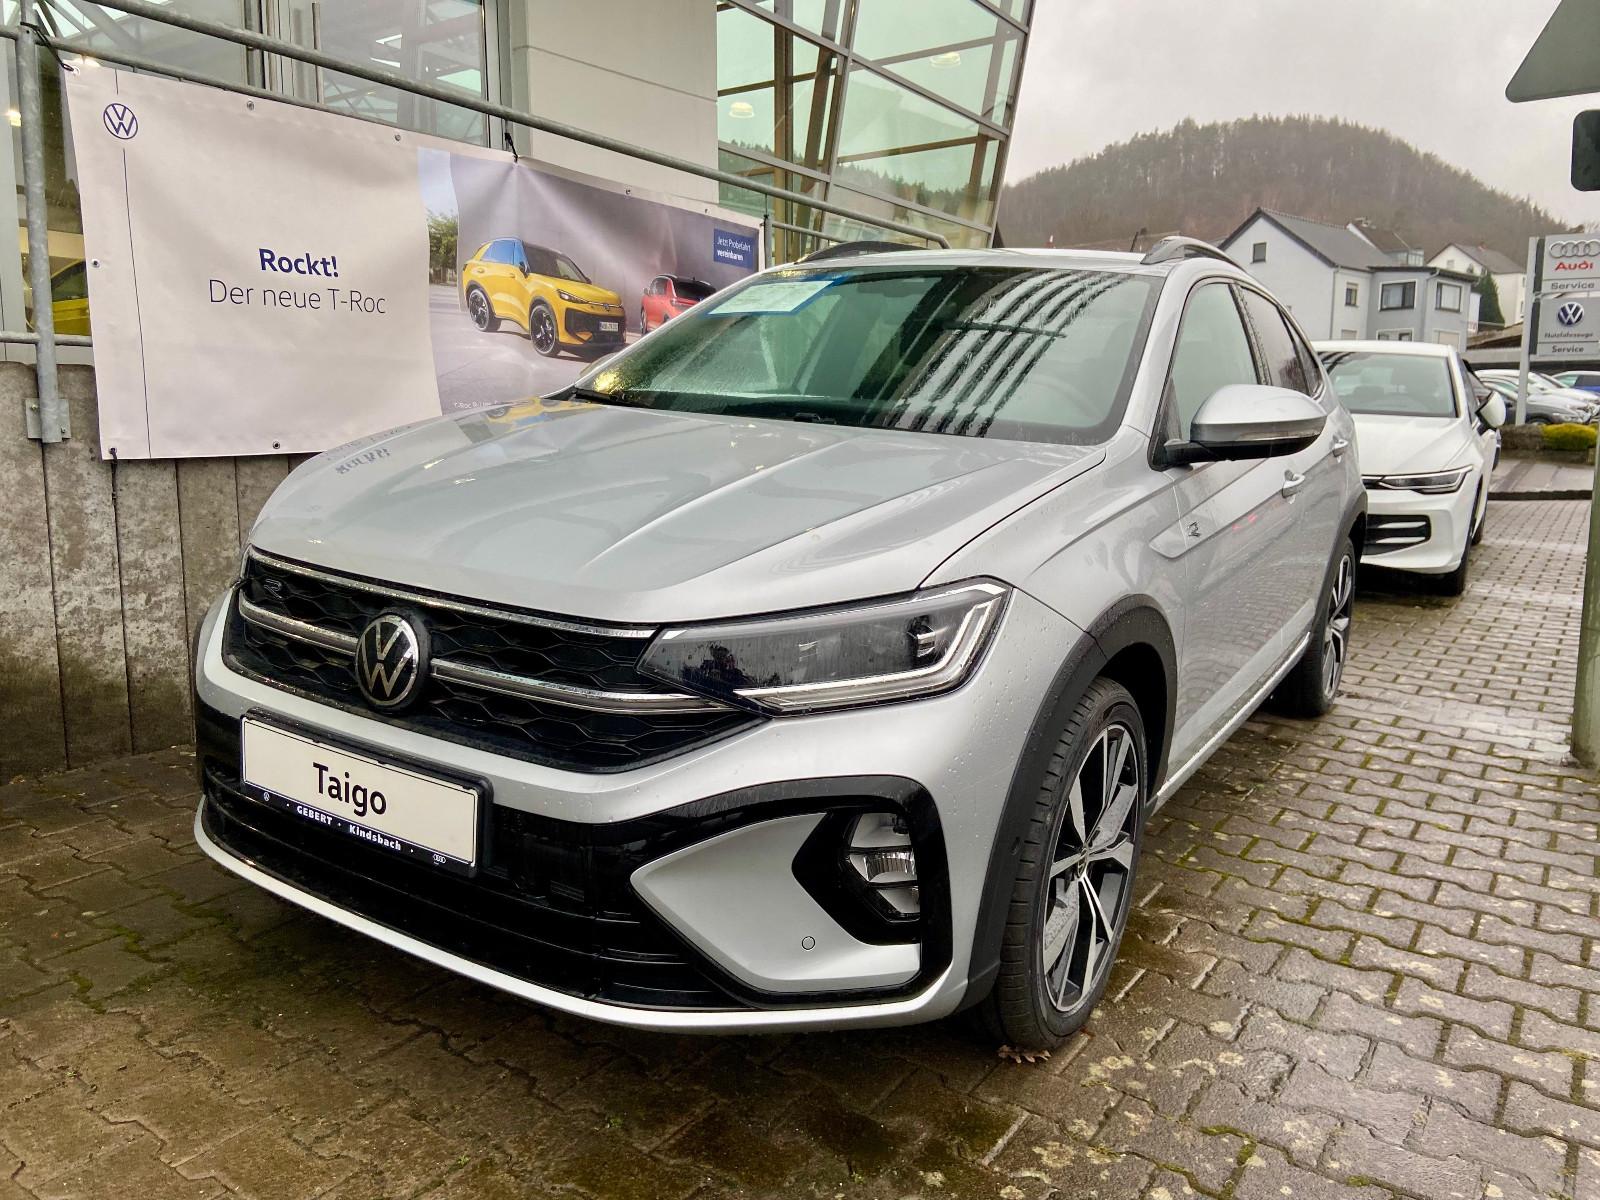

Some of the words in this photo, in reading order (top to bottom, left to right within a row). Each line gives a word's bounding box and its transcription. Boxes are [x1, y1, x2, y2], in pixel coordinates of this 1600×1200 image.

[103, 103, 138, 139] VW
[259, 248, 339, 278] Rockt!
[717, 250, 744, 261] vereinbaren
[1555, 261, 1593, 271] Audi
[209, 279, 255, 305] Der
[263, 289, 321, 310] neue
[327, 288, 386, 314] T-Roc
[1551, 282, 1595, 290] Service
[1557, 302, 1584, 327] VW
[1551, 345, 1585, 353] Service
[355, 615, 419, 706] VW
[312, 762, 387, 817] Taigo
[296, 805, 332, 825] GEBERT
[349, 825, 401, 851] Kindsbach
